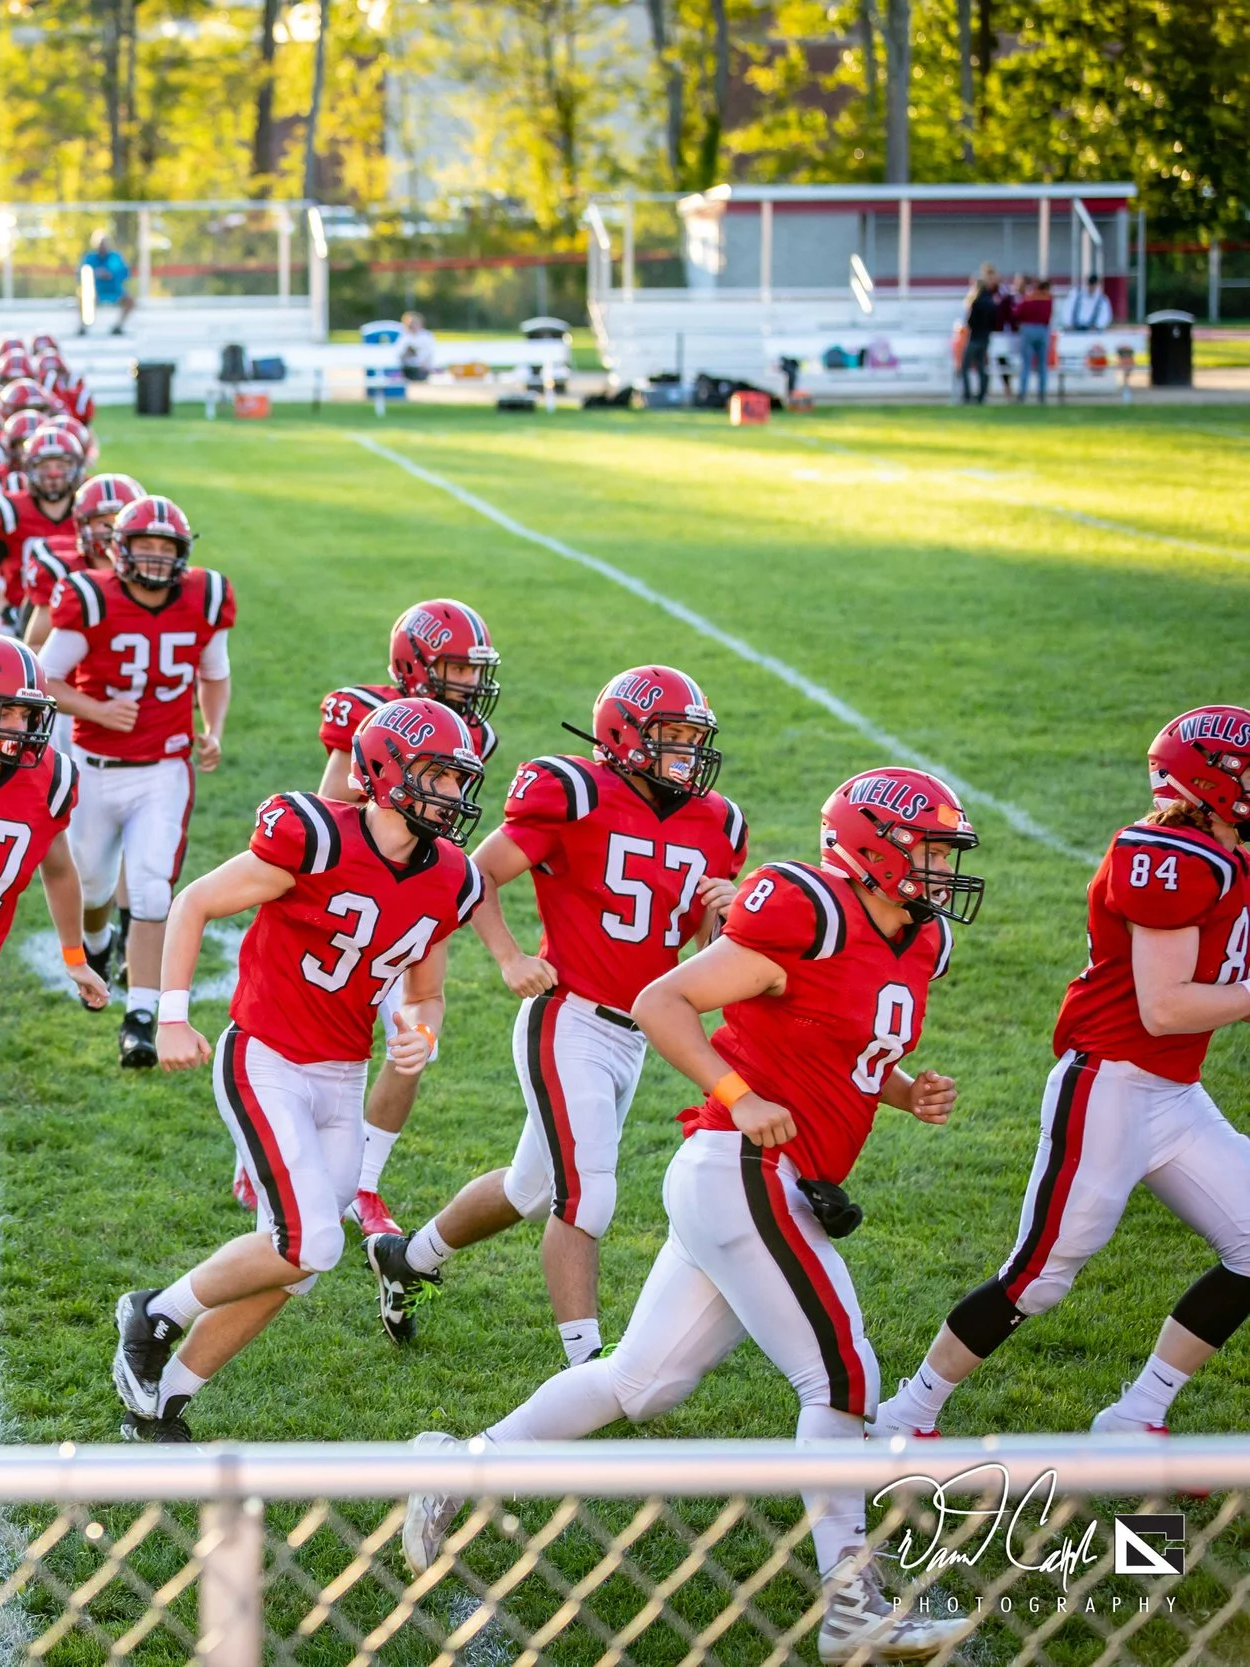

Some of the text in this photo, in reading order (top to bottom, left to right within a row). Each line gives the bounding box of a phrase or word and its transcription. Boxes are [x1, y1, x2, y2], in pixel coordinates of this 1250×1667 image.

[105, 631, 197, 703] 35
[323, 697, 353, 728] 33
[1179, 714, 1250, 748] WELLS
[507, 769, 539, 801] 57
[849, 777, 928, 821] WELLS
[601, 831, 708, 948] 57
[1129, 853, 1179, 891] 84
[743, 876, 776, 914] 8
[300, 890, 441, 1007] 34
[850, 980, 915, 1096] 8
